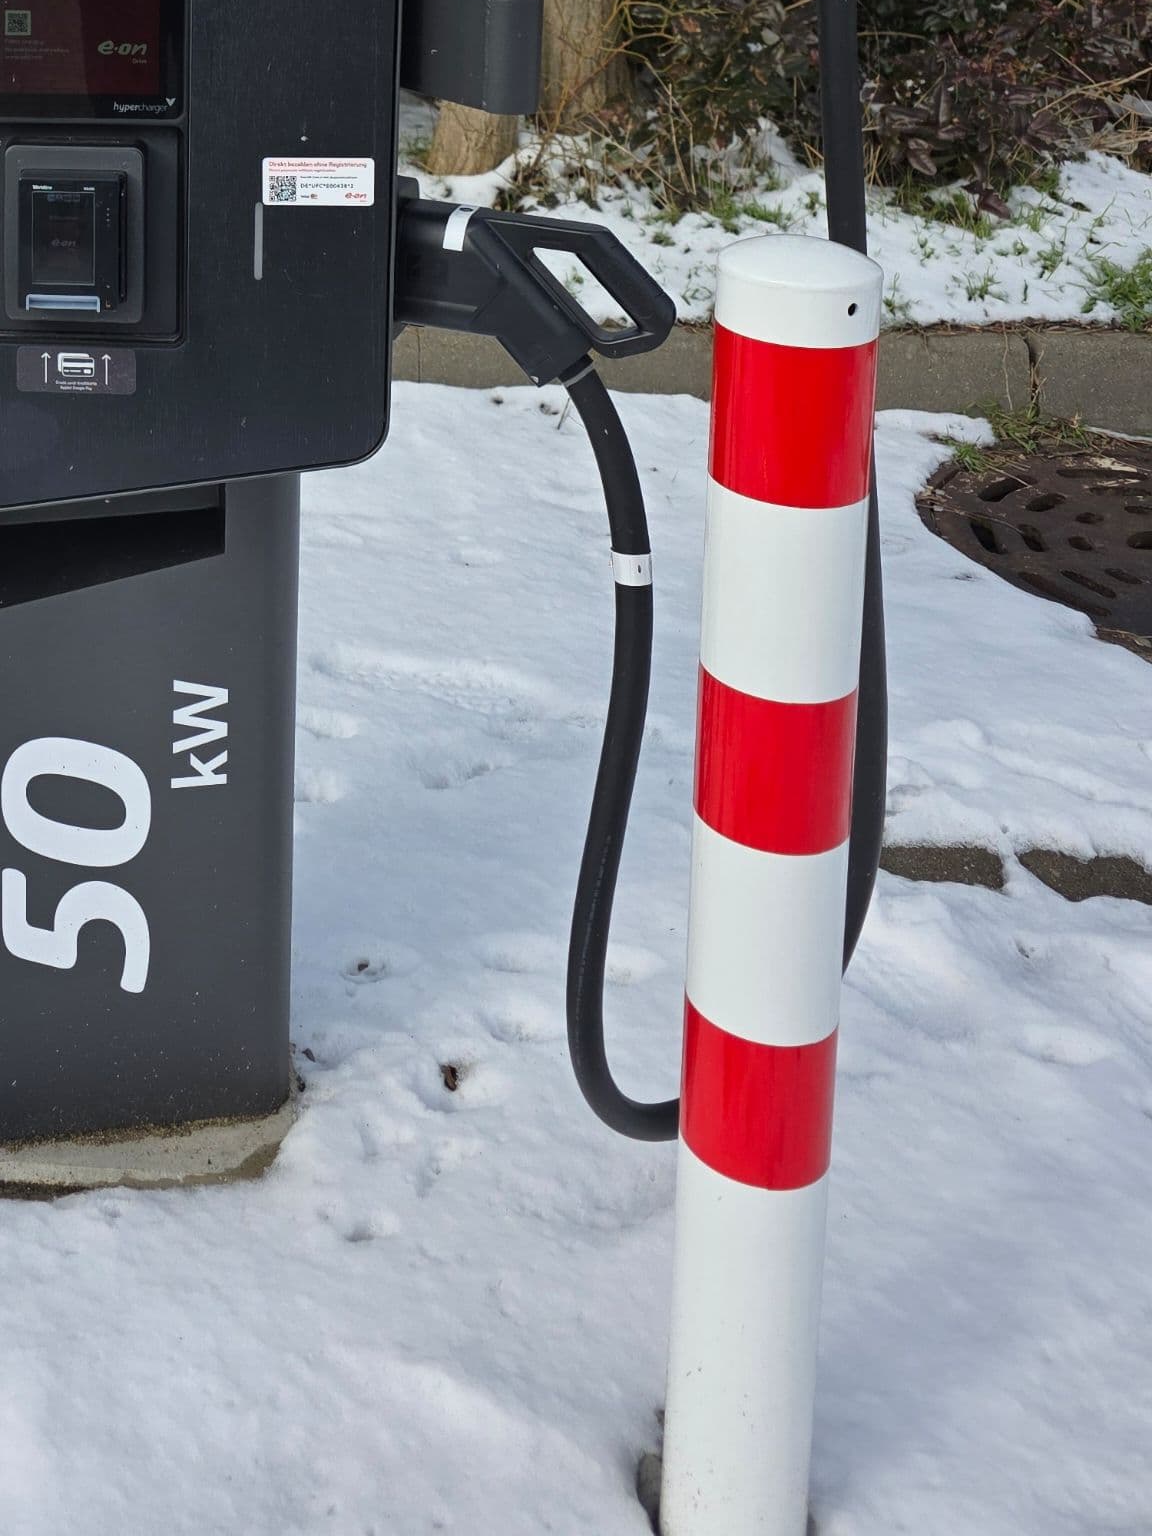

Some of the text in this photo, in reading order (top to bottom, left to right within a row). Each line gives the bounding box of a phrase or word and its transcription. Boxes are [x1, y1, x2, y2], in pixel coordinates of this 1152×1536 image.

[113, 101, 168, 114] hypercharger
[171, 679, 229, 789] kW
[1, 736, 151, 994] 50
